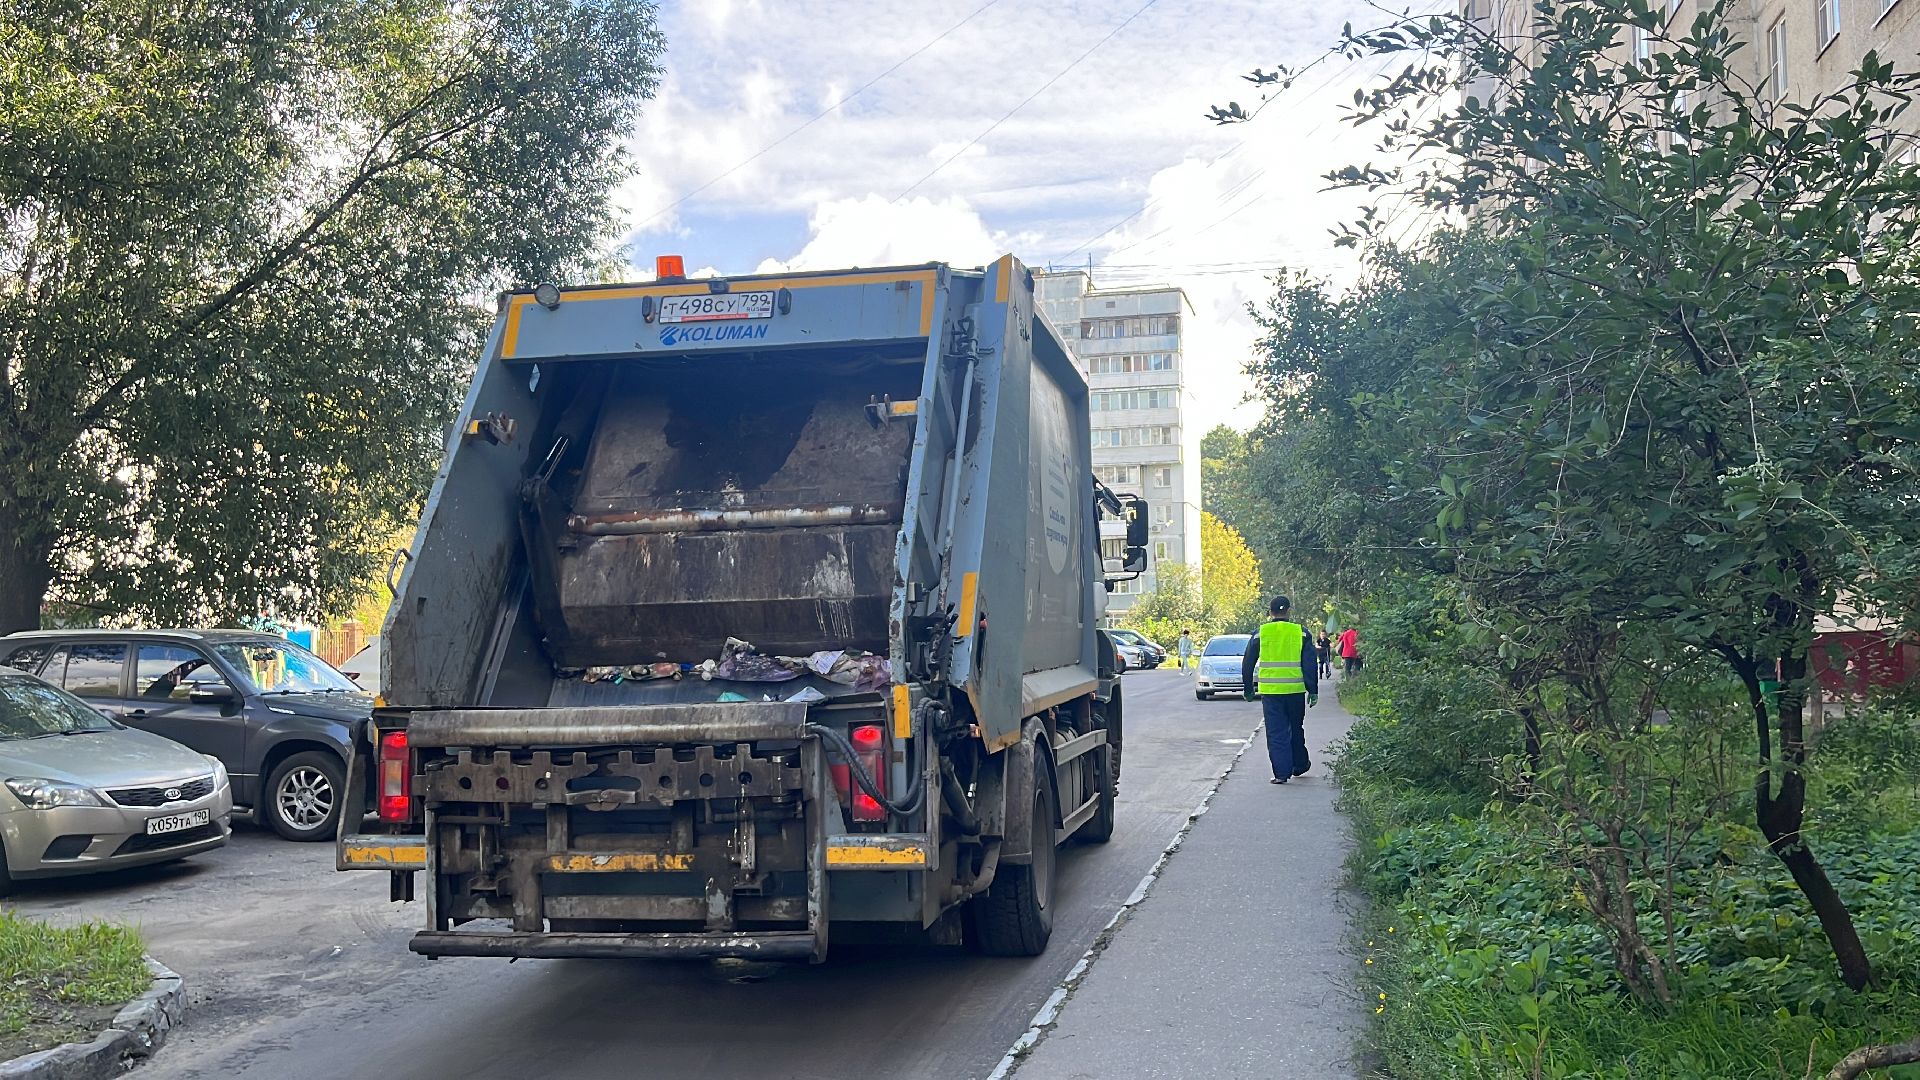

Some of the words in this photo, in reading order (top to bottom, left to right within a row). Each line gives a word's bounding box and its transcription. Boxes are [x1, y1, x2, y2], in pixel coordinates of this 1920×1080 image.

[741, 294, 768, 308] 799
[678, 324, 768, 341] KOLUMAN
[193, 810, 207, 822] 190
